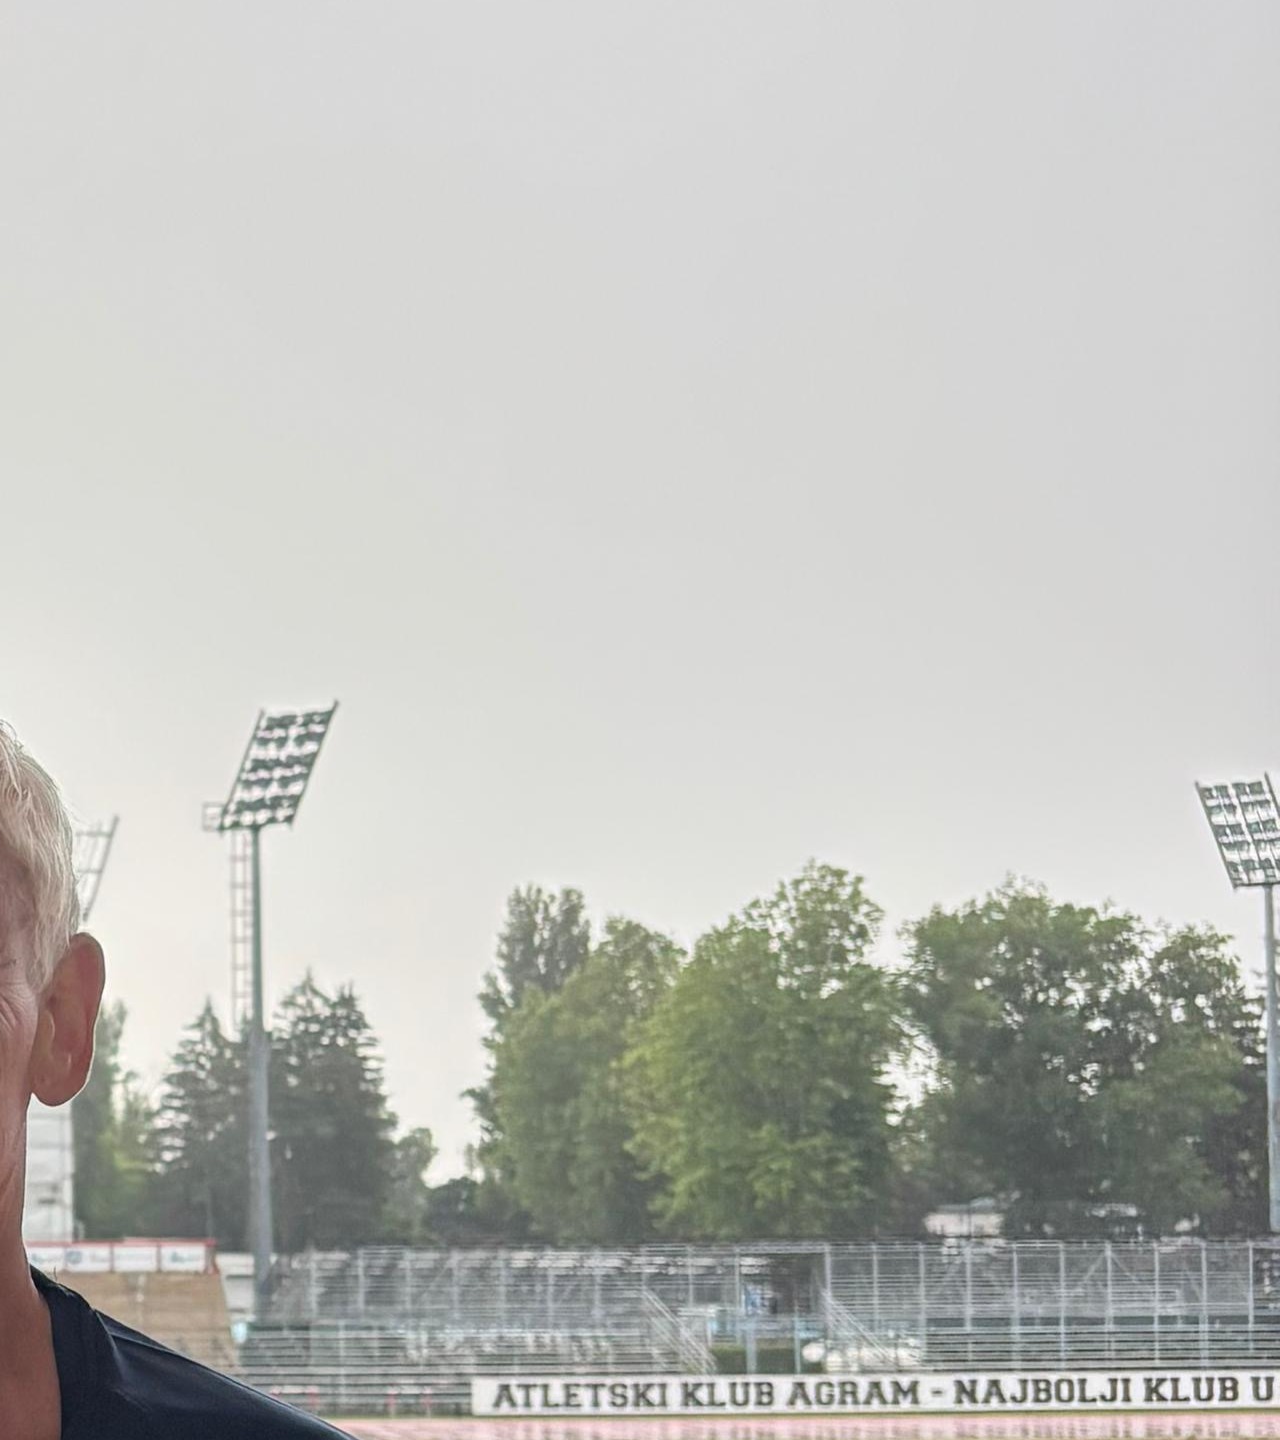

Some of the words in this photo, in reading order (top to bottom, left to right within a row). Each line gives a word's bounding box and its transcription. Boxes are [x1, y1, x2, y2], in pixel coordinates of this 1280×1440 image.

[492, 1382, 668, 1408] ATLETSKI
[680, 1381, 775, 1407] KLUB
[789, 1380, 920, 1406] AGRAM
[953, 1378, 1132, 1404] NAJBOLJI
[1142, 1376, 1239, 1402] KLUB
